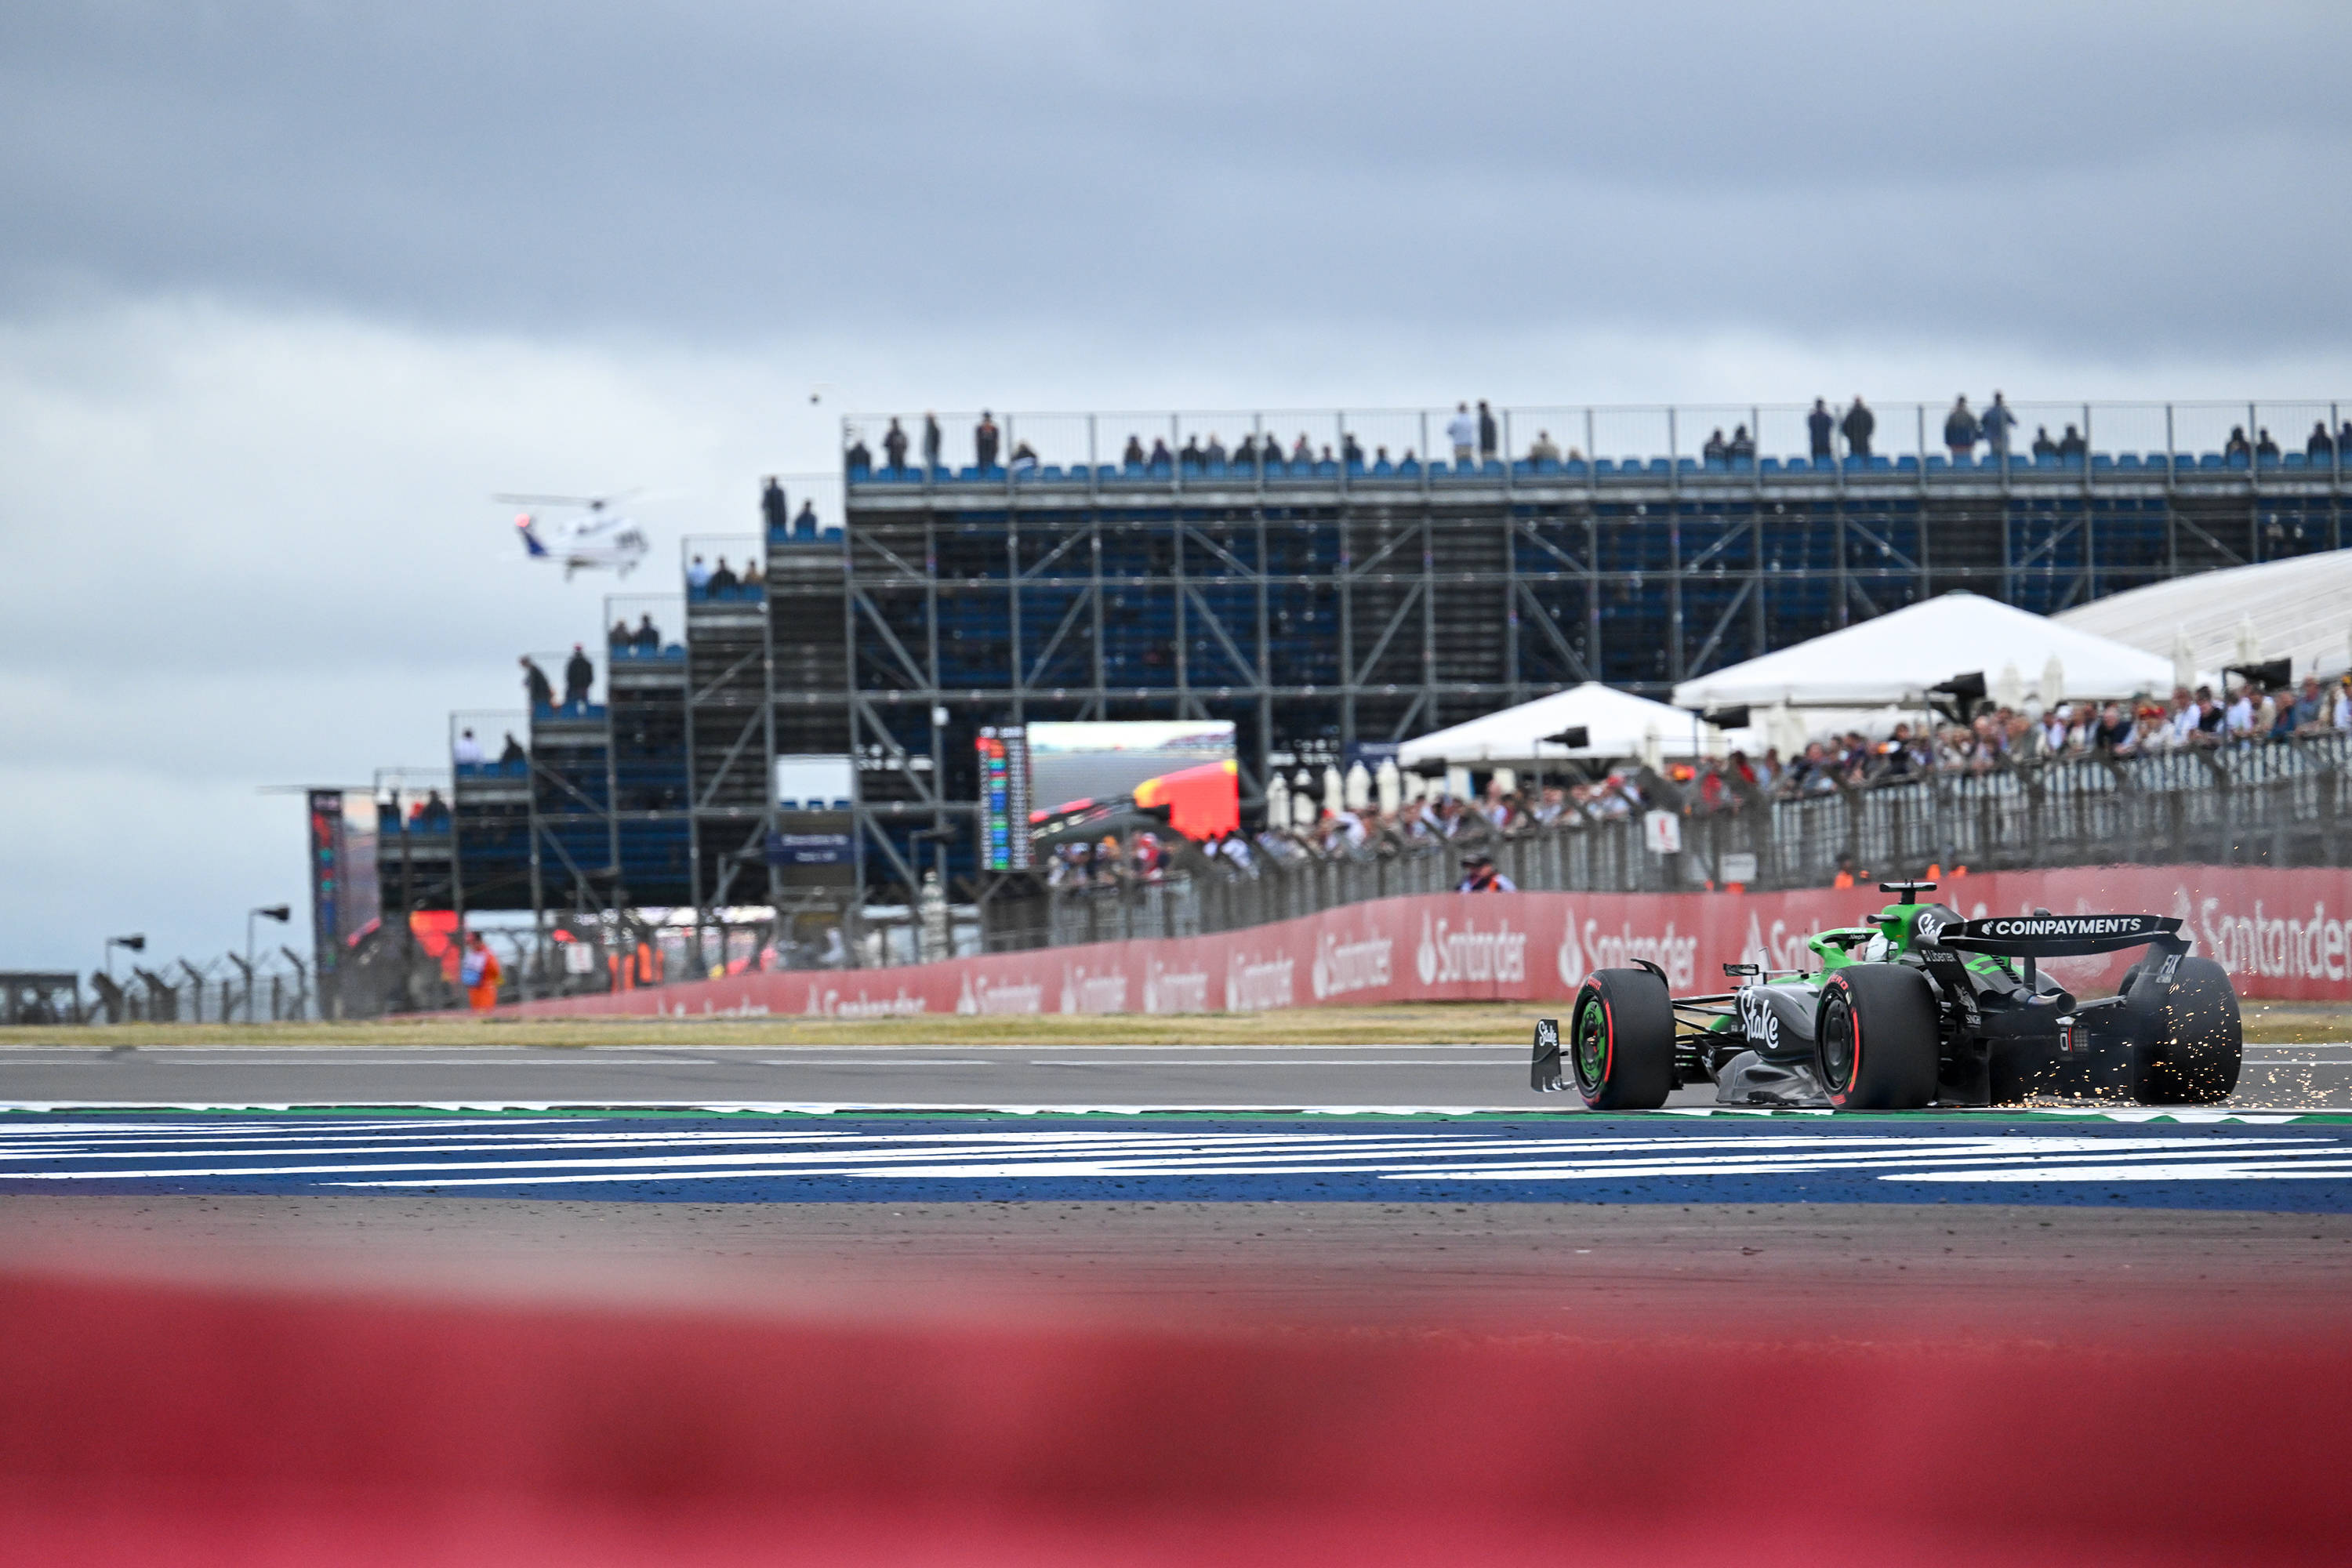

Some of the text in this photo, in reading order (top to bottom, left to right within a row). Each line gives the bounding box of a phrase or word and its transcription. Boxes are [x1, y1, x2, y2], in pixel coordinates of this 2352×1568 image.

[1996, 918, 2142, 935] COINPAYMENTS
[2160, 954, 2182, 974] FIX
[1740, 989, 1779, 1049] Stake
[1538, 1021, 1558, 1047] Stake
